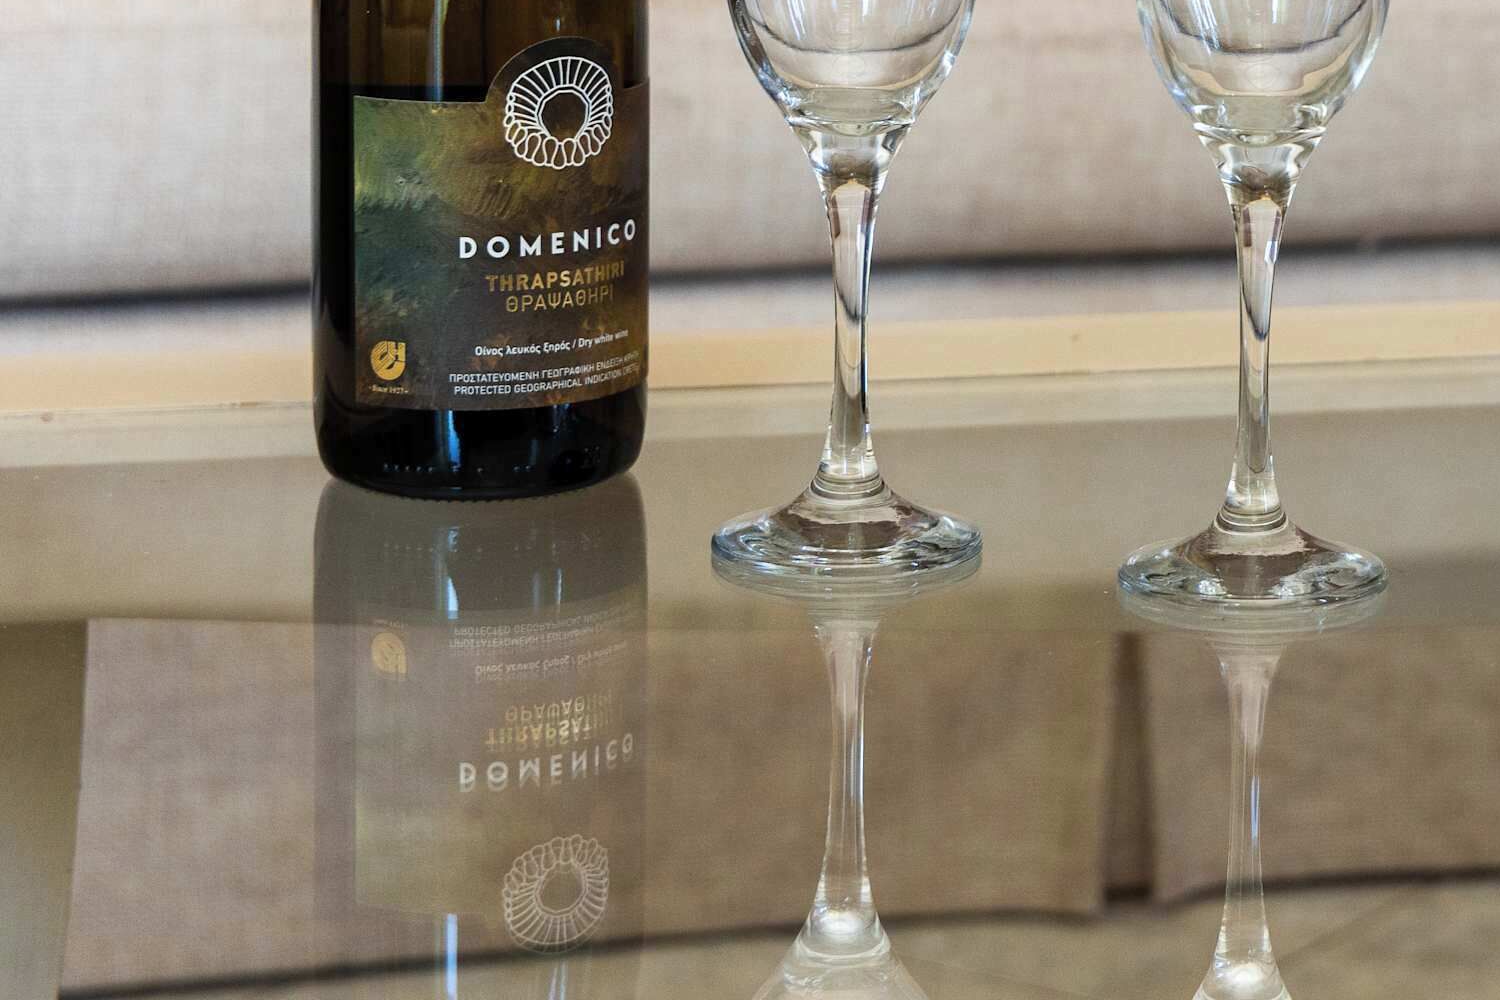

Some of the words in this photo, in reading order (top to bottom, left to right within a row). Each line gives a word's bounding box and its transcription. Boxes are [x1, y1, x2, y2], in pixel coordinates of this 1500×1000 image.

[458, 218, 637, 260] DOMENICO
[484, 260, 625, 293] THRAPSATHIRI
[578, 337, 593, 349] Dry
[454, 384, 512, 396] PROTECTED
[514, 376, 583, 393] GEOGRAPHICAL
